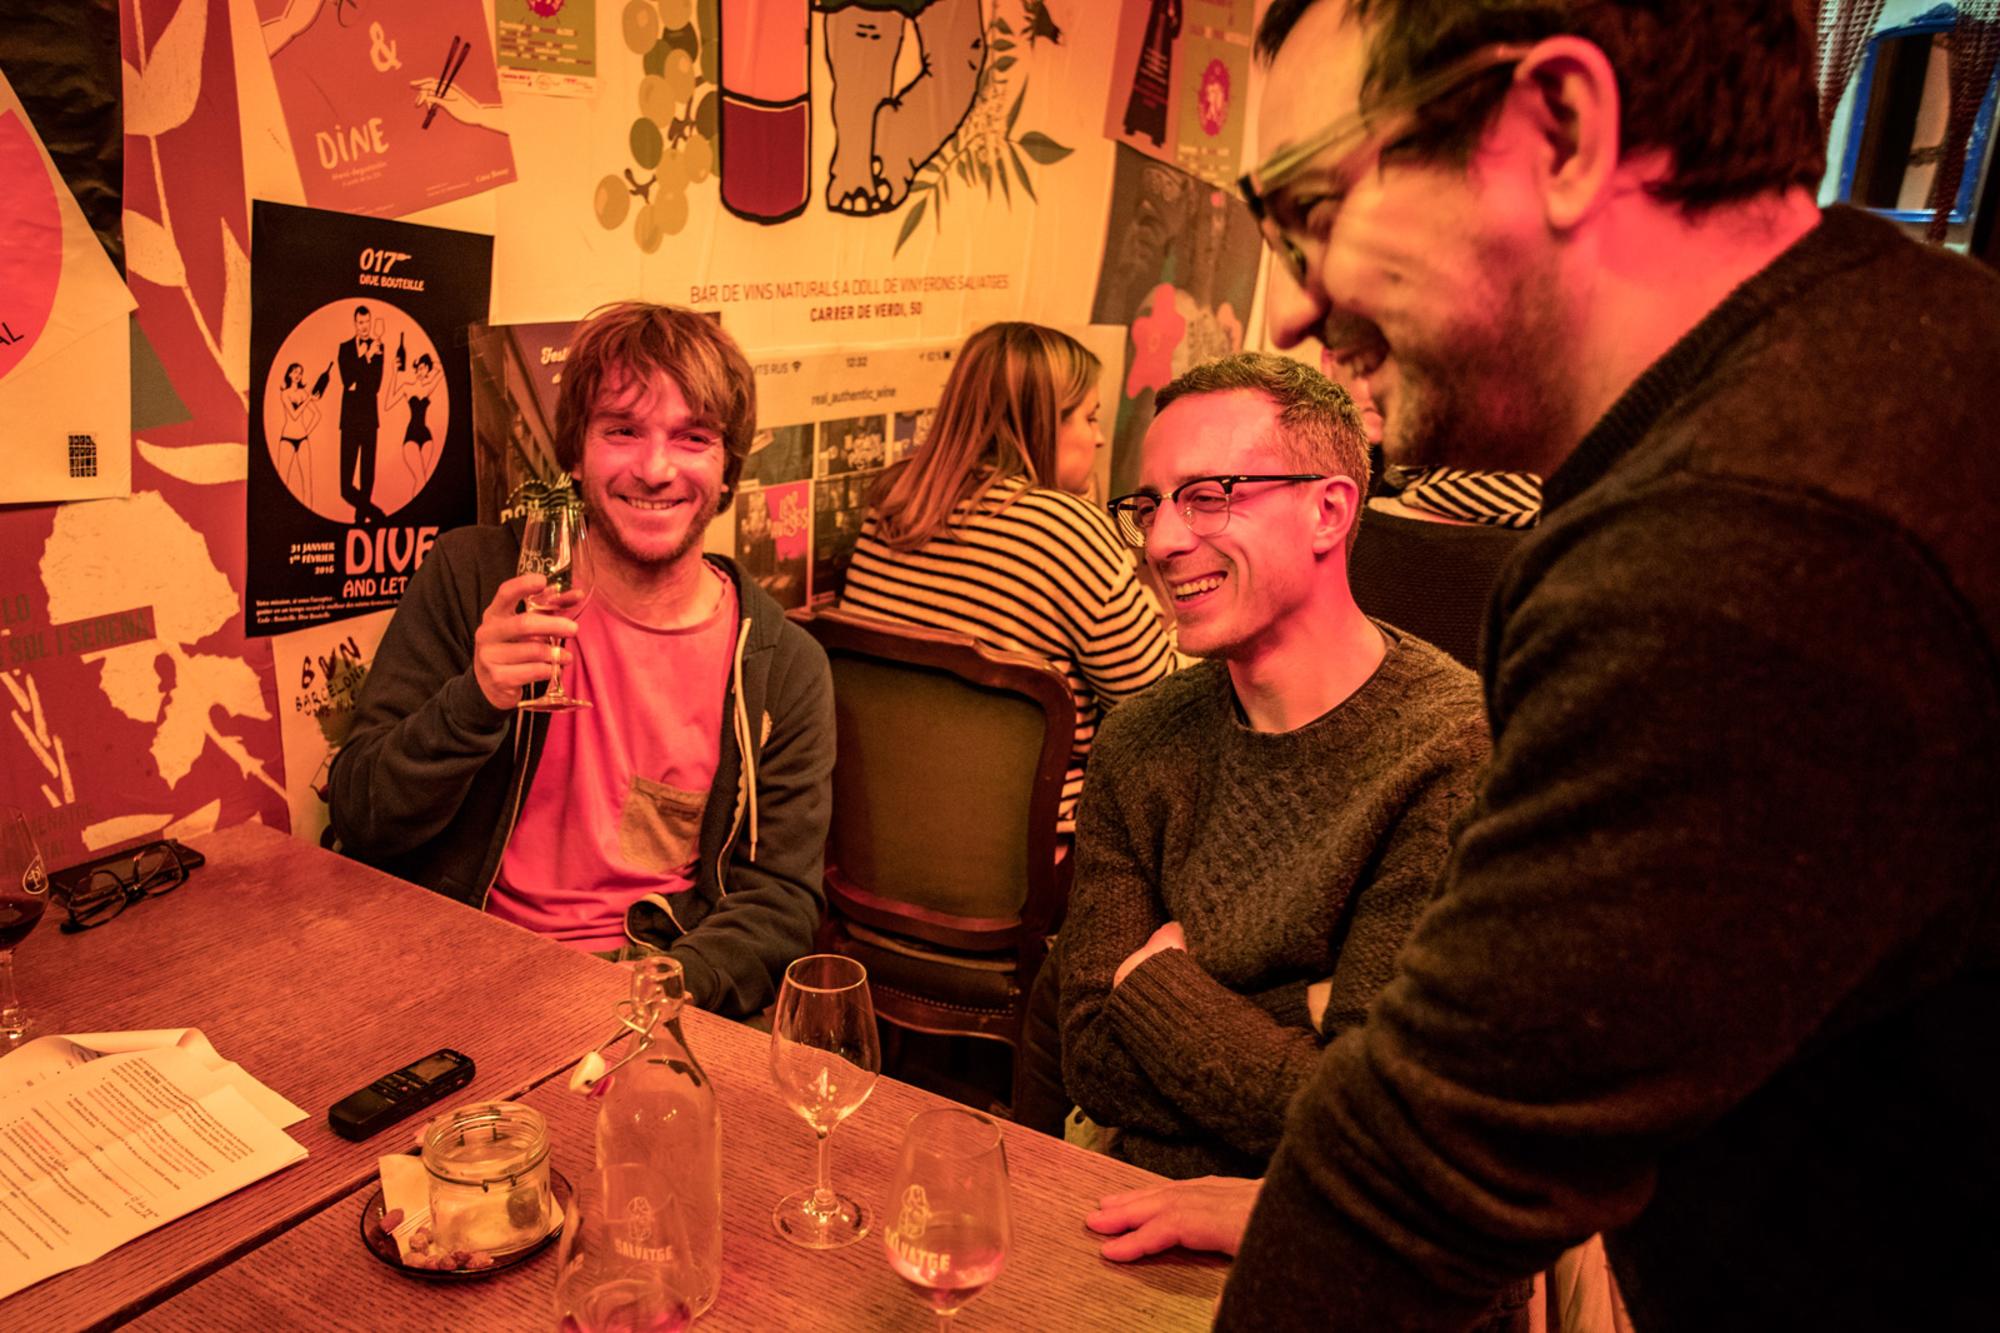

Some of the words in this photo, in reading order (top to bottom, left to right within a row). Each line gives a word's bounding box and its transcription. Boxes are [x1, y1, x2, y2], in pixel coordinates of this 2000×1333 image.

[359, 247, 398, 274] 017
[381, 275, 425, 292] BOUTEILLE
[690, 285, 718, 304] BAR
[722, 284, 740, 302] DE
[743, 282, 773, 301] VINS
[776, 280, 839, 299] NATURALS
[842, 280, 850, 295] A
[884, 278, 898, 294] DE
[810, 304, 854, 322] CARRER
[857, 304, 871, 319] DE
[874, 302, 908, 318] VERDI,
[811, 387, 897, 406] real_authentic_wine
[302, 541, 335, 554] JANVIER
[342, 577, 377, 598] AND
[380, 576, 408, 595] LET
